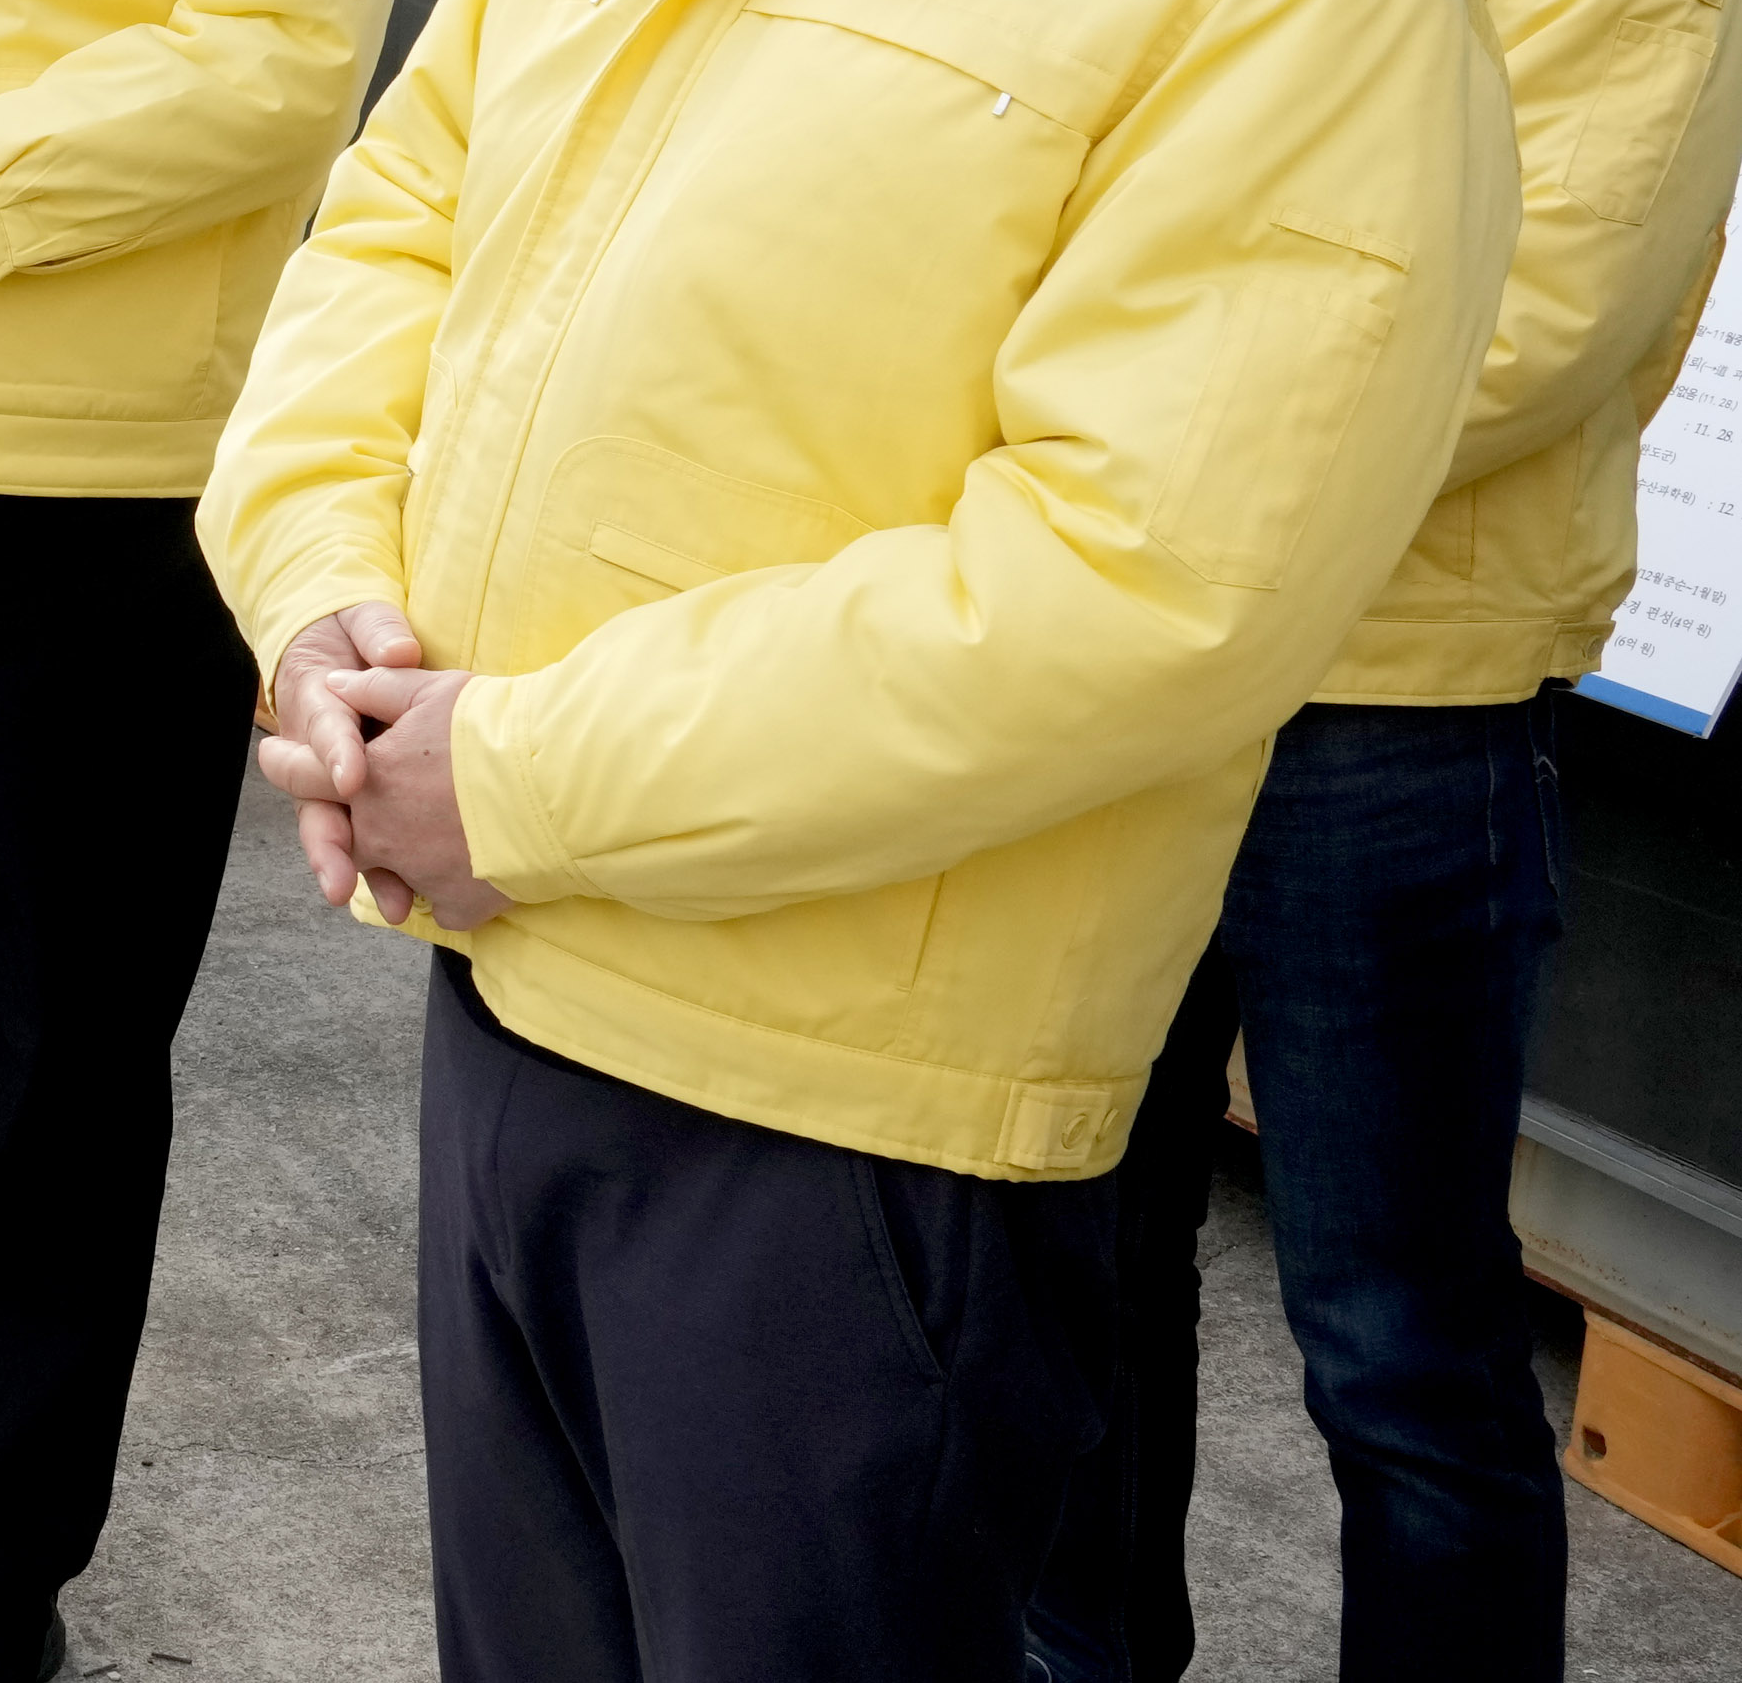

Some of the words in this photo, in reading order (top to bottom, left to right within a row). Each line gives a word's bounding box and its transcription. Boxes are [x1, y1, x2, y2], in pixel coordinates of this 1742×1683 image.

[1696, 623, 1712, 639] 원)
[1614, 635, 1638, 651] (6억
[1640, 642, 1656, 658] 원)
